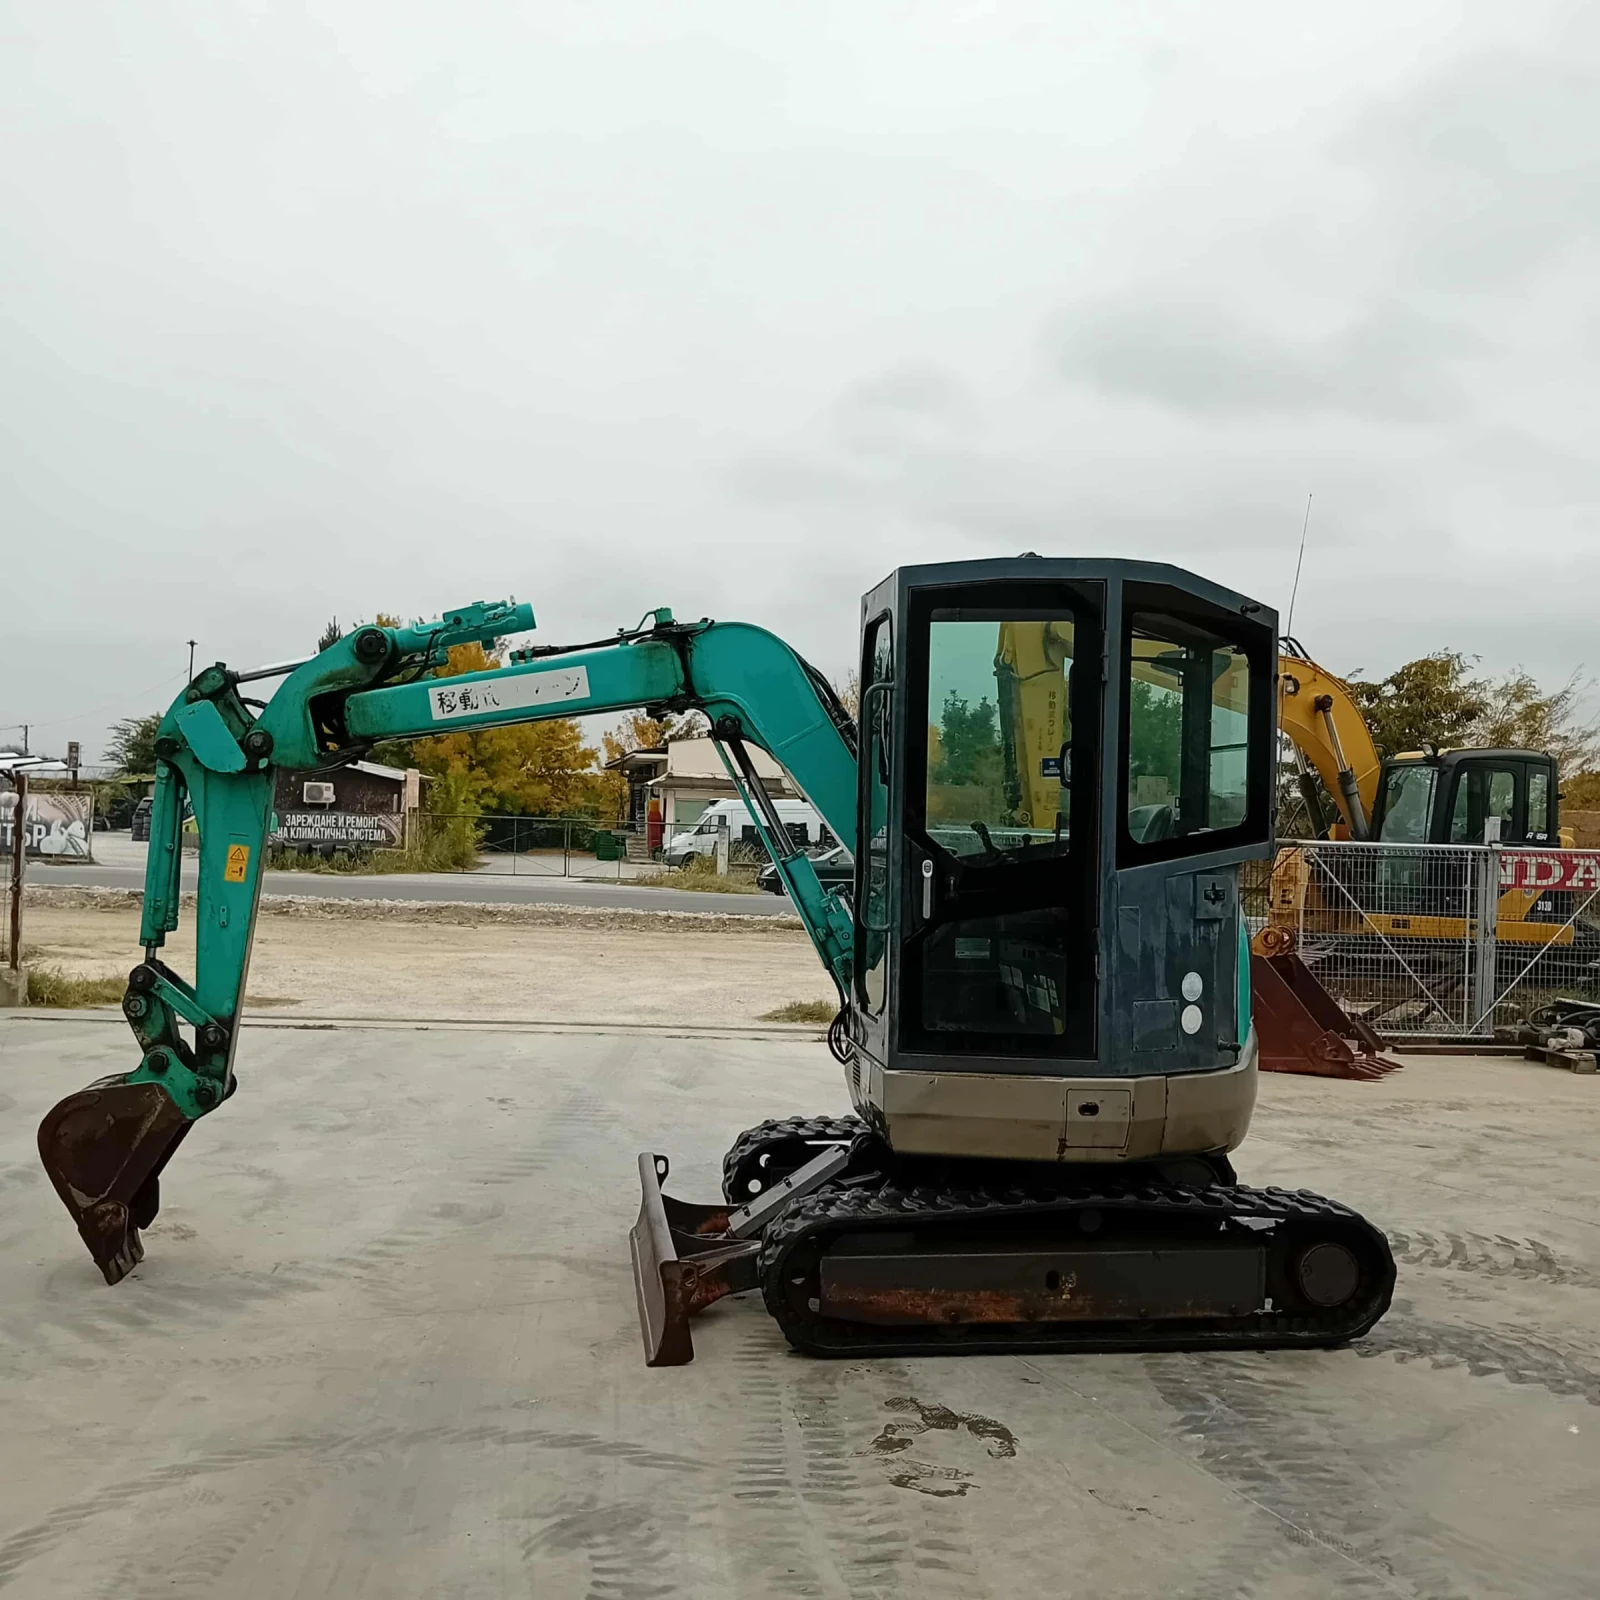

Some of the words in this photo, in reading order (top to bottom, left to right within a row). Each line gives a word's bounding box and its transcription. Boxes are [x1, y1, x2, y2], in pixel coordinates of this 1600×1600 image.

[285, 814, 337, 828] ЗАРЕЖДАНЕ
[339, 816, 346, 828] И
[346, 816, 379, 829] РЕМОНТ
[277, 827, 289, 839] НА
[290, 827, 347, 840] КЛИМАТИЧНА
[348, 828, 386, 841] СИСТЕМА
